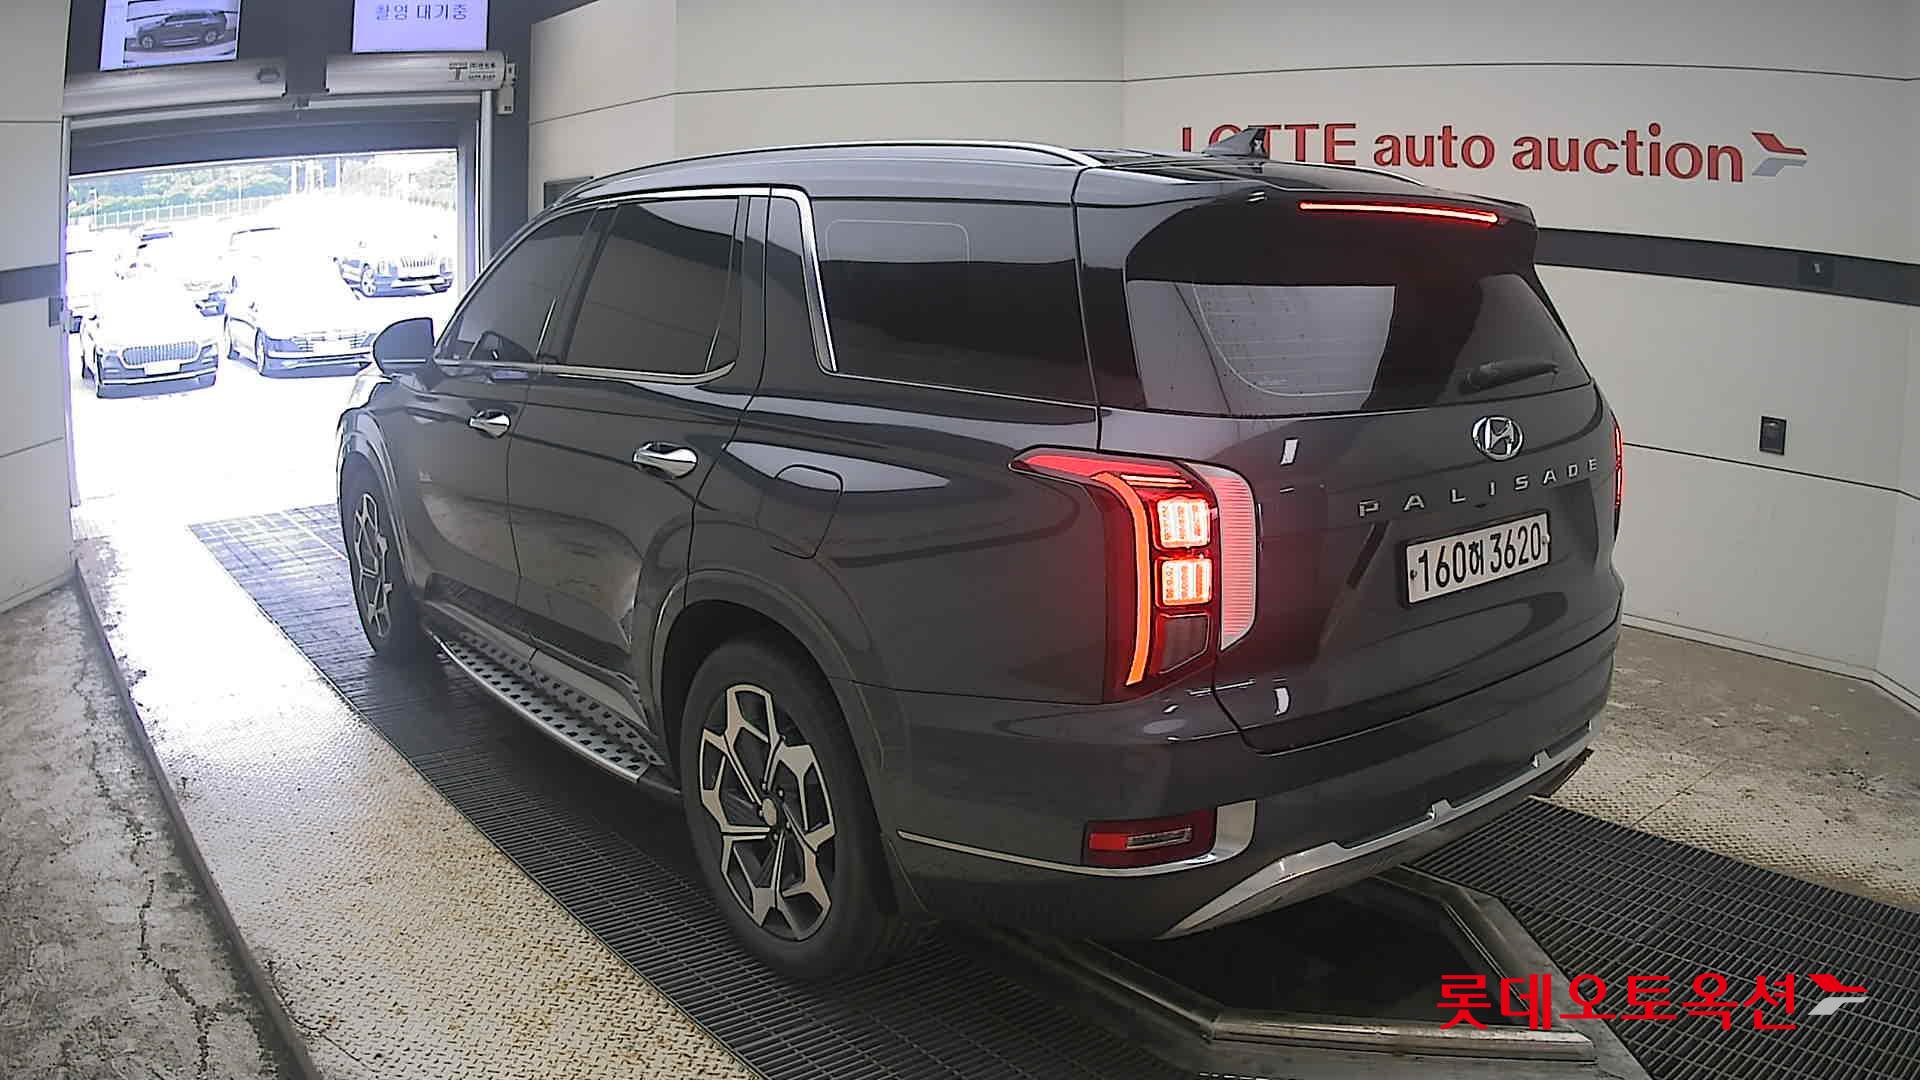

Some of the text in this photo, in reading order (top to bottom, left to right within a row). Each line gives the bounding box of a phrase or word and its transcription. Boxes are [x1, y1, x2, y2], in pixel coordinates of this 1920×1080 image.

[1373, 125, 1495, 169] auto
[1511, 122, 1744, 183] auction
[1358, 458, 1598, 518] PALISADE
